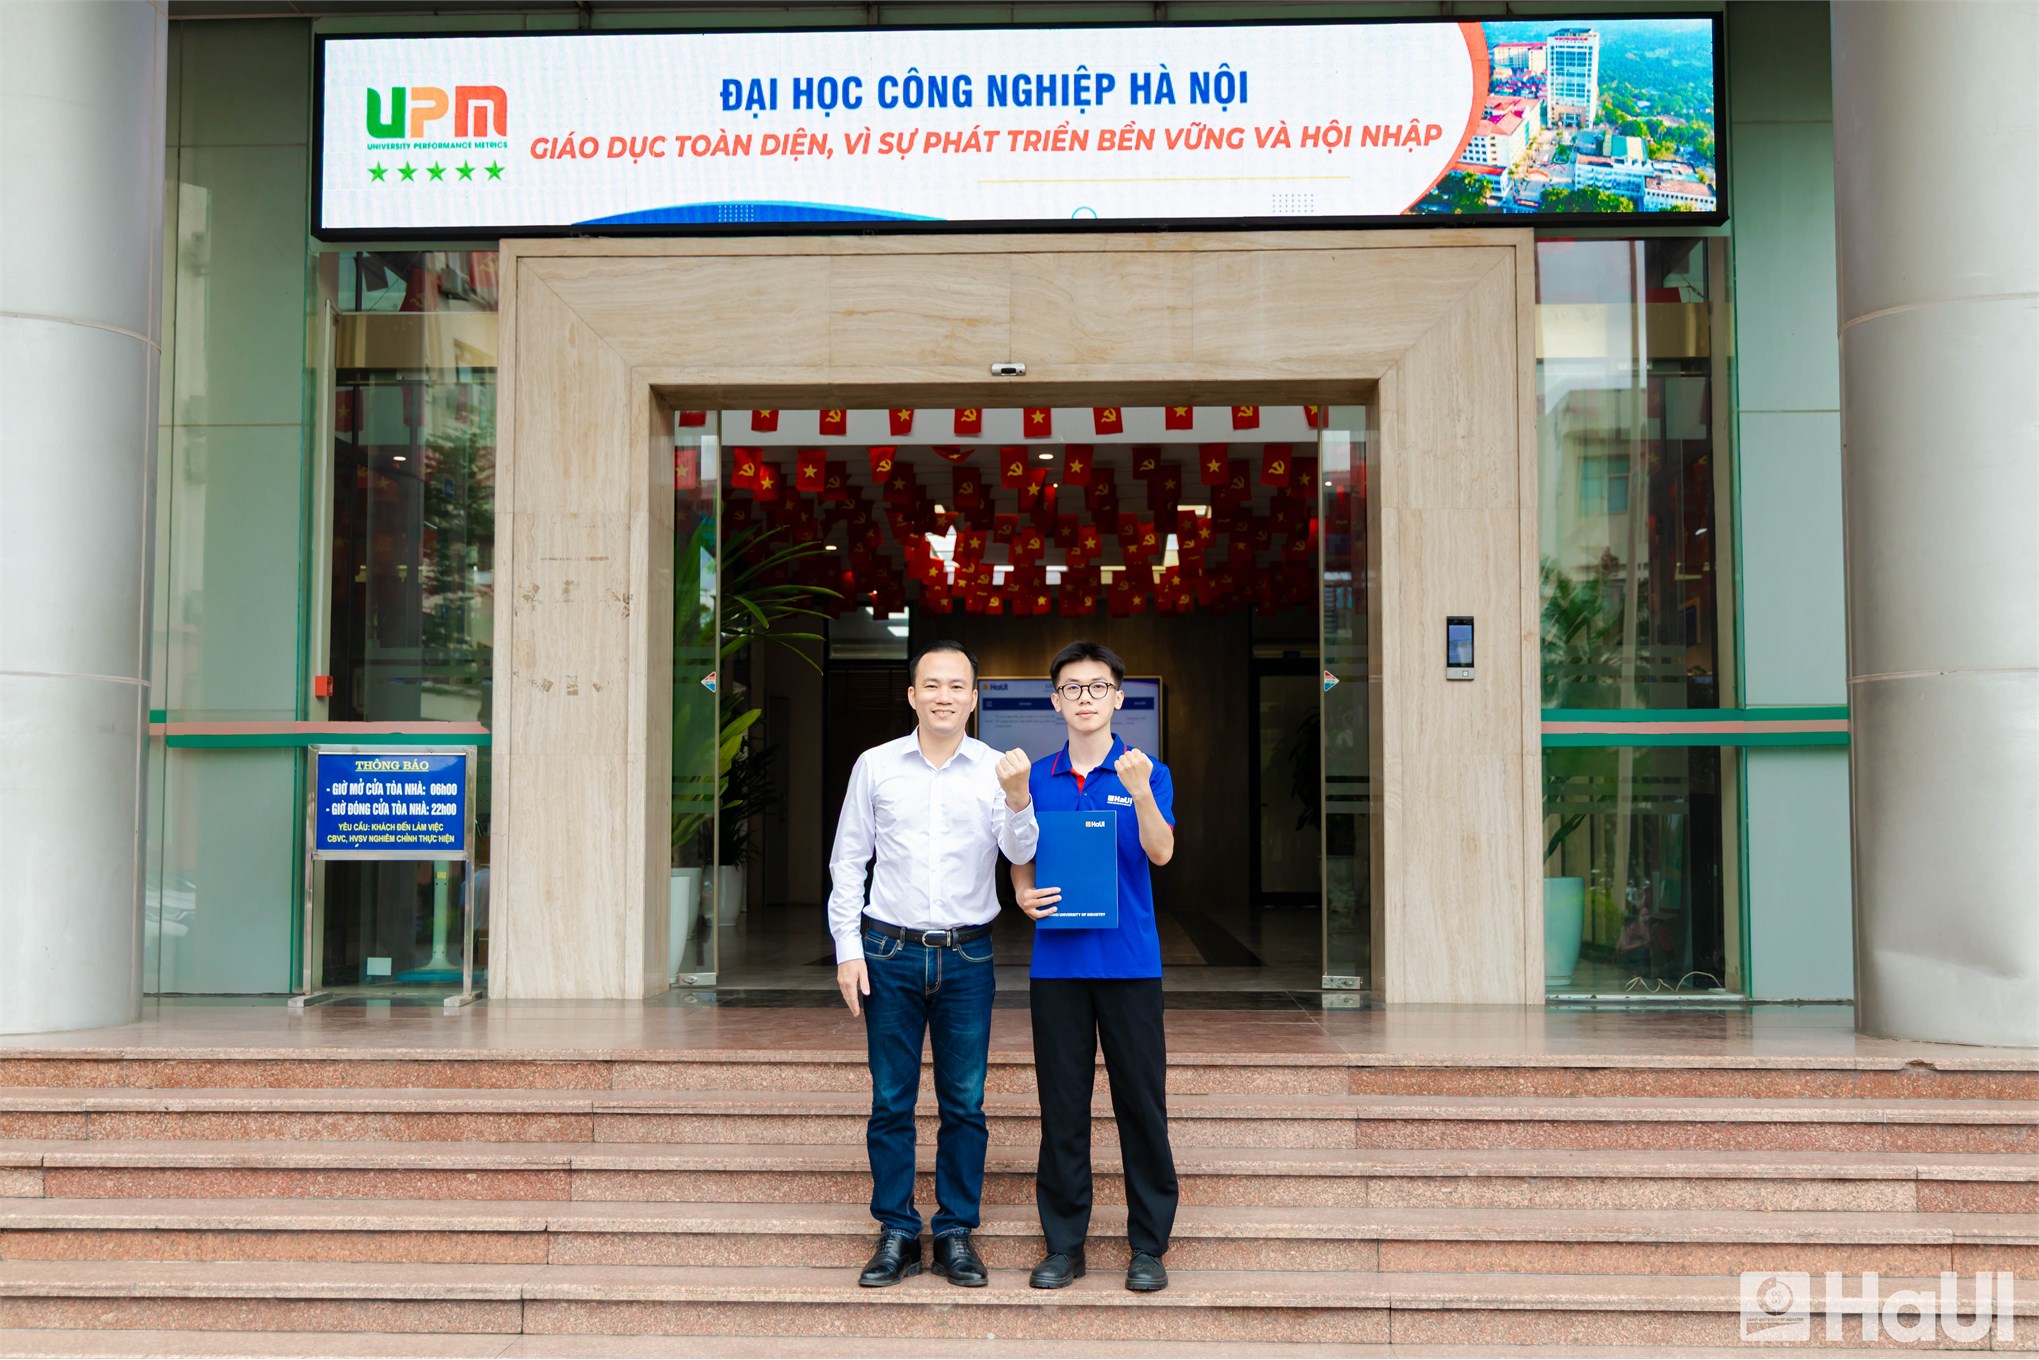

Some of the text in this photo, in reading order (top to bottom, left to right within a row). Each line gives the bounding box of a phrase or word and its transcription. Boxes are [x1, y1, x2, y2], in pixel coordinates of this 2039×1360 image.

[720, 63, 1248, 119] ĐẠI HỌC CÔNG NGHIỆP HÀ NỘI
[367, 141, 508, 150] UNIVERSITY PERFORMANCE METRICS
[530, 118, 1443, 164] GIÁO DỤC TOÀN DIỆN, VÌ SỰ PHÁT TRIỂN BỀN VỮNG VÀ HỘI NHẬP
[355, 758, 430, 771] THÔNG BÁO
[332, 779, 348, 796] GIỜ
[349, 778, 365, 796] MỞ
[366, 777, 384, 796] CỬA
[386, 780, 403, 796] TÒA
[404, 780, 426, 796] NHÀ:
[430, 783, 458, 796] 06h00
[331, 800, 347, 816] GIỜ
[347, 800, 371, 816] ĐÓNG
[372, 798, 390, 816] CỬA
[391, 800, 408, 816] TÒA
[409, 800, 430, 816] NHÀ:
[431, 802, 457, 816] 22h00
[338, 821, 352, 831] YÊU
[371, 821, 396, 831] KHÁCH
[396, 820, 411, 831] ĐẾN
[412, 821, 427, 831] LÀM
[428, 821, 444, 833] VIỆC
[368, 833, 396, 843] NGHIÊM
[419, 834, 438, 844] THỰC
[438, 833, 455, 844] HIỆN
